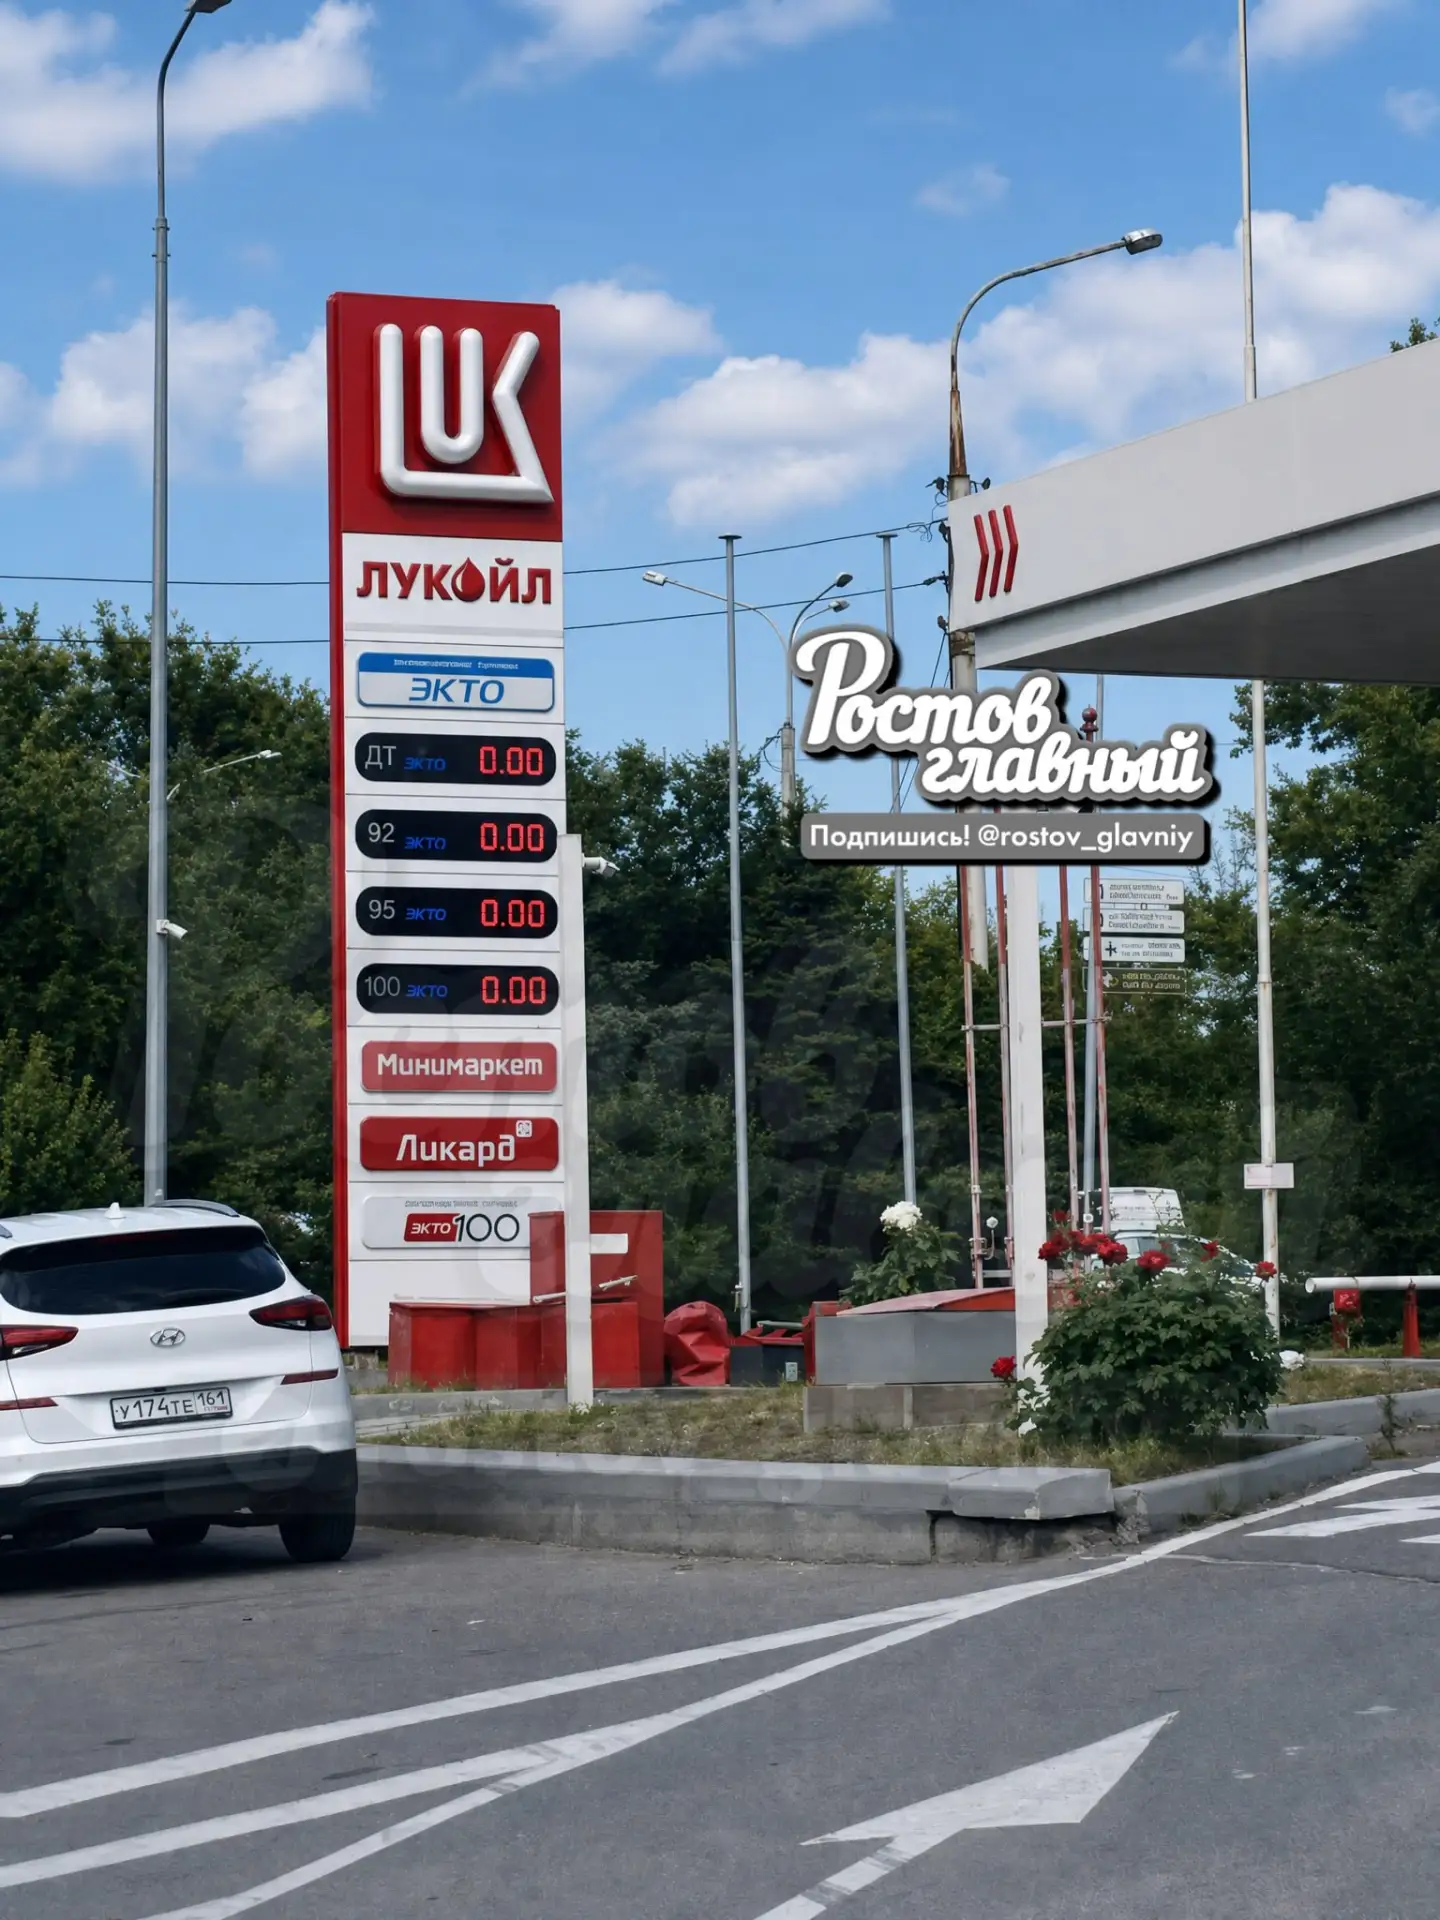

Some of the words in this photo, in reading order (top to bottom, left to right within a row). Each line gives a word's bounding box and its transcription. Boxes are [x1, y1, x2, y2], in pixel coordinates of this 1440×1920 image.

[356, 556, 552, 604] ЛУКОЙЛ
[408, 677, 505, 704] ЭКТО
[365, 744, 397, 770] ДТ
[403, 756, 446, 771] ЭКТО
[479, 745, 544, 776] 0.00
[368, 822, 395, 844] 92
[404, 836, 446, 851] ЭКТО
[480, 822, 545, 852] 0.00
[369, 899, 396, 920] 95
[405, 907, 447, 921] ЭКТО
[481, 899, 546, 928] 0.00
[364, 976, 401, 998] 100
[405, 984, 448, 998] ЭКТО
[481, 975, 547, 1005] 0.00
[377, 1053, 543, 1081] Минимаркет
[396, 1134, 516, 1167] Ликард
